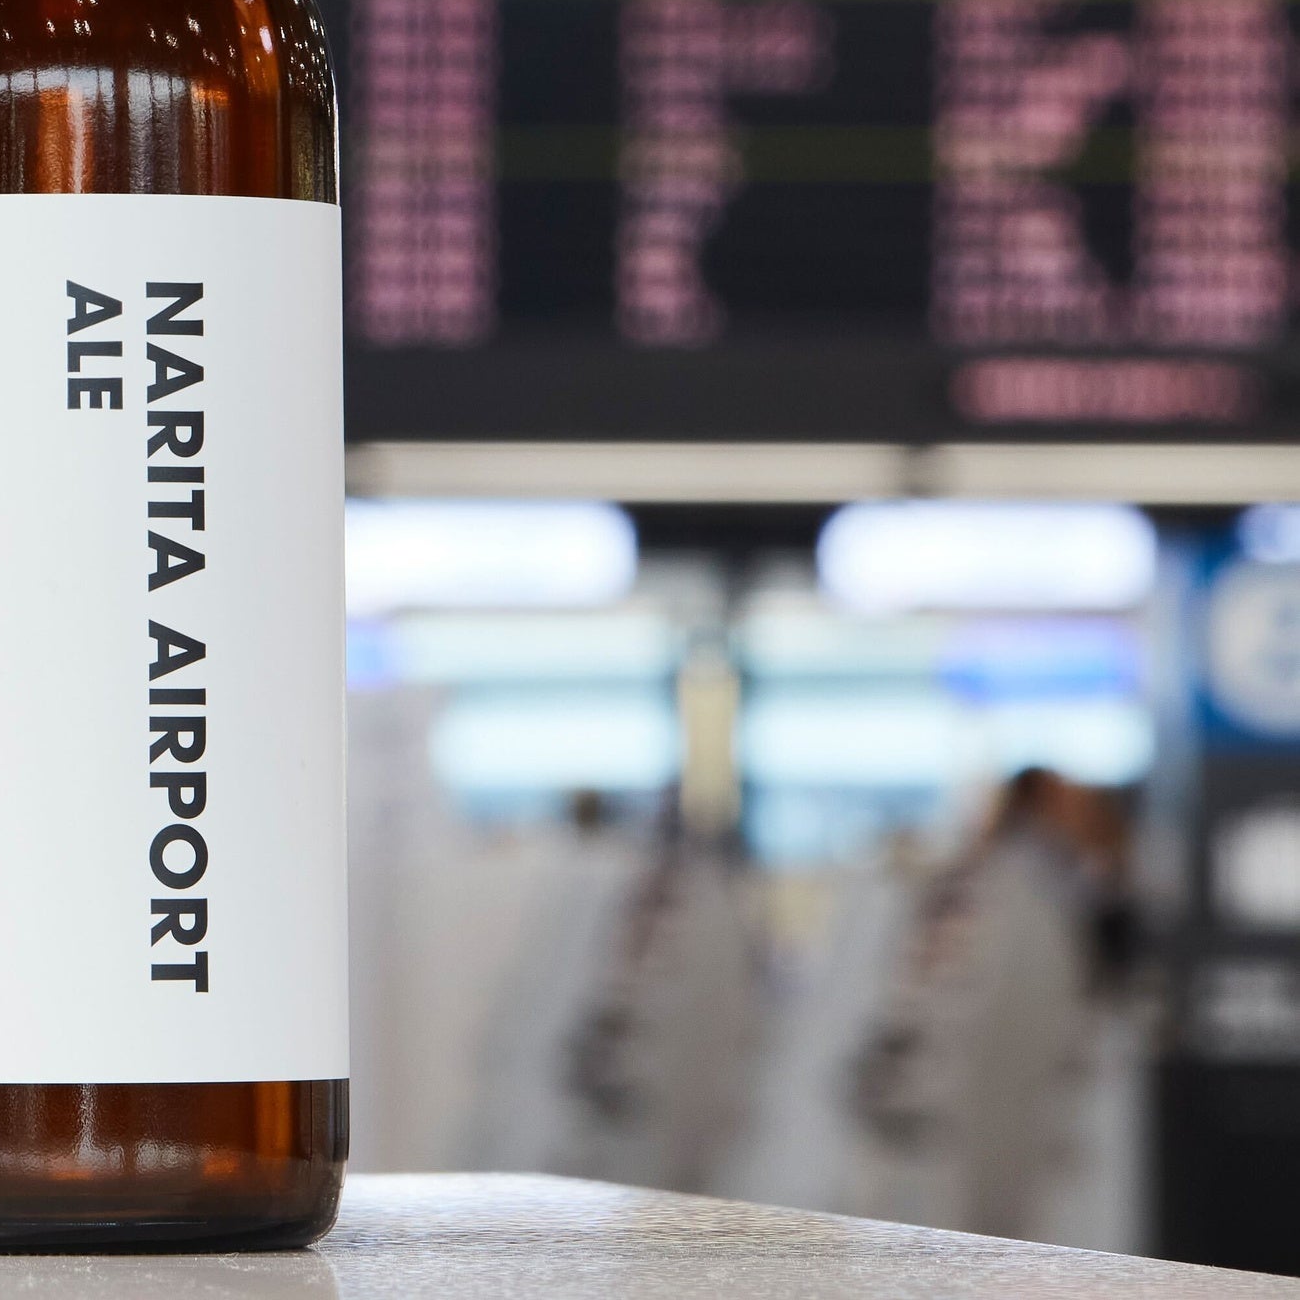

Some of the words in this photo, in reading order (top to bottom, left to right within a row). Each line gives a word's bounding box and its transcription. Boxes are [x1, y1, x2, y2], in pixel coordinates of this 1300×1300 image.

[67, 280, 123, 410] ALE
[146, 281, 206, 593] NARITA
[148, 619, 209, 993] AIRPORT
